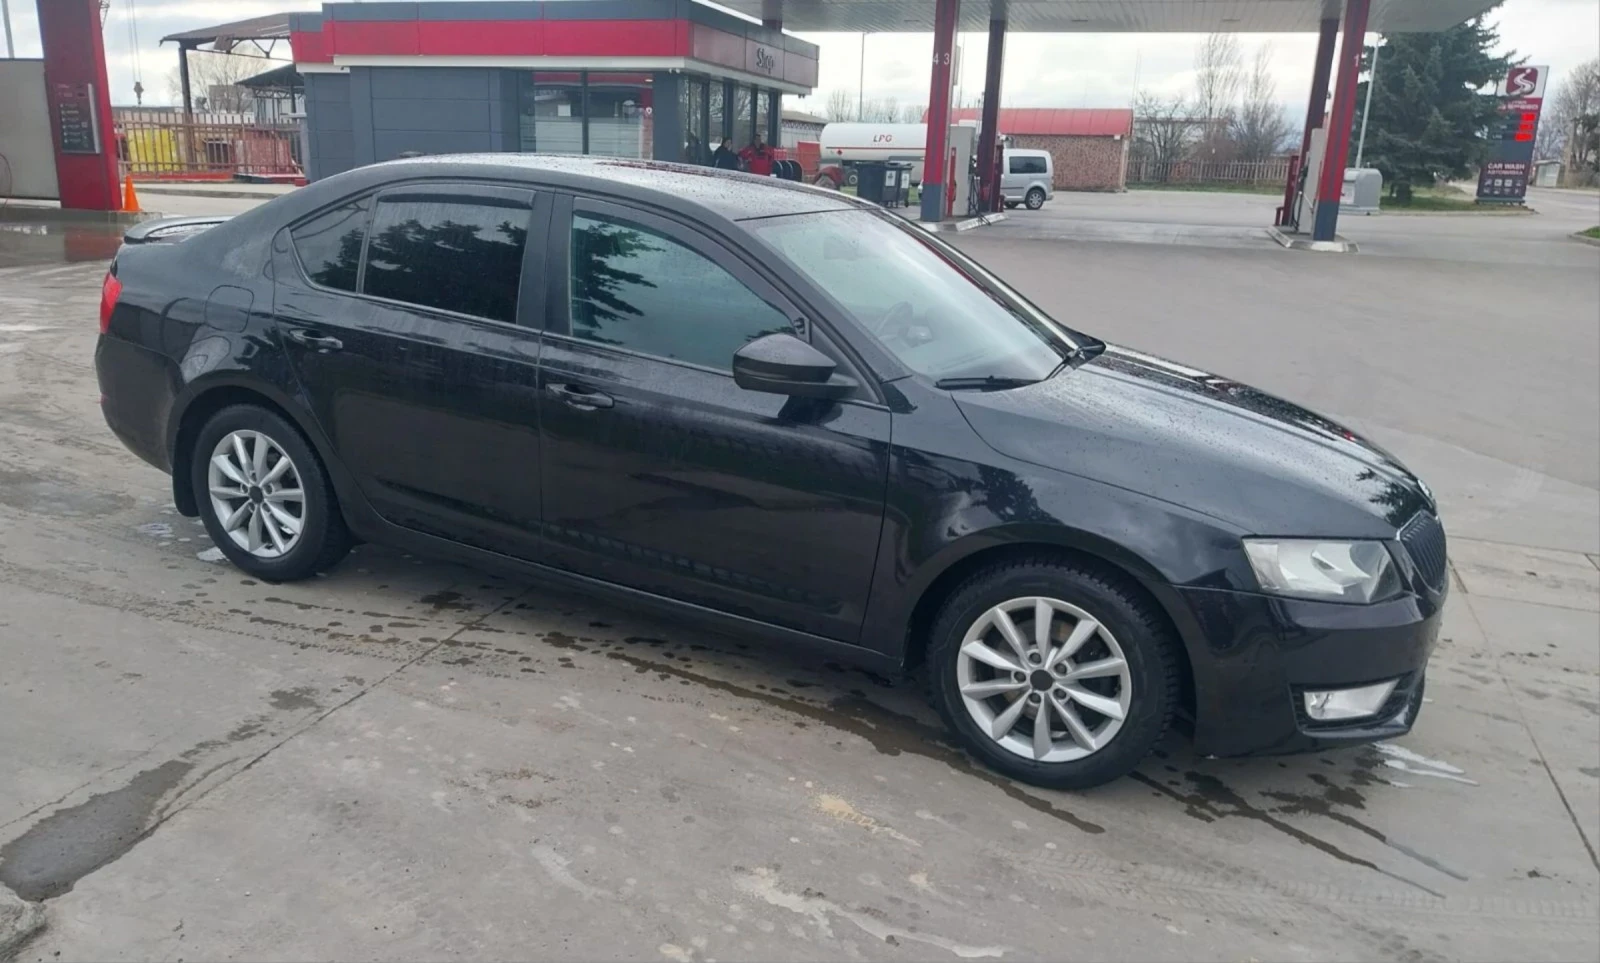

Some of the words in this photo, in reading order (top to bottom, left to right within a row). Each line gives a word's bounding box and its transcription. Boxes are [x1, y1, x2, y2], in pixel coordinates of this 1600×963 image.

[756, 47, 774, 75] Shop
[932, 52, 939, 65] 4
[943, 52, 950, 65] 3
[873, 134, 893, 143] LPG
